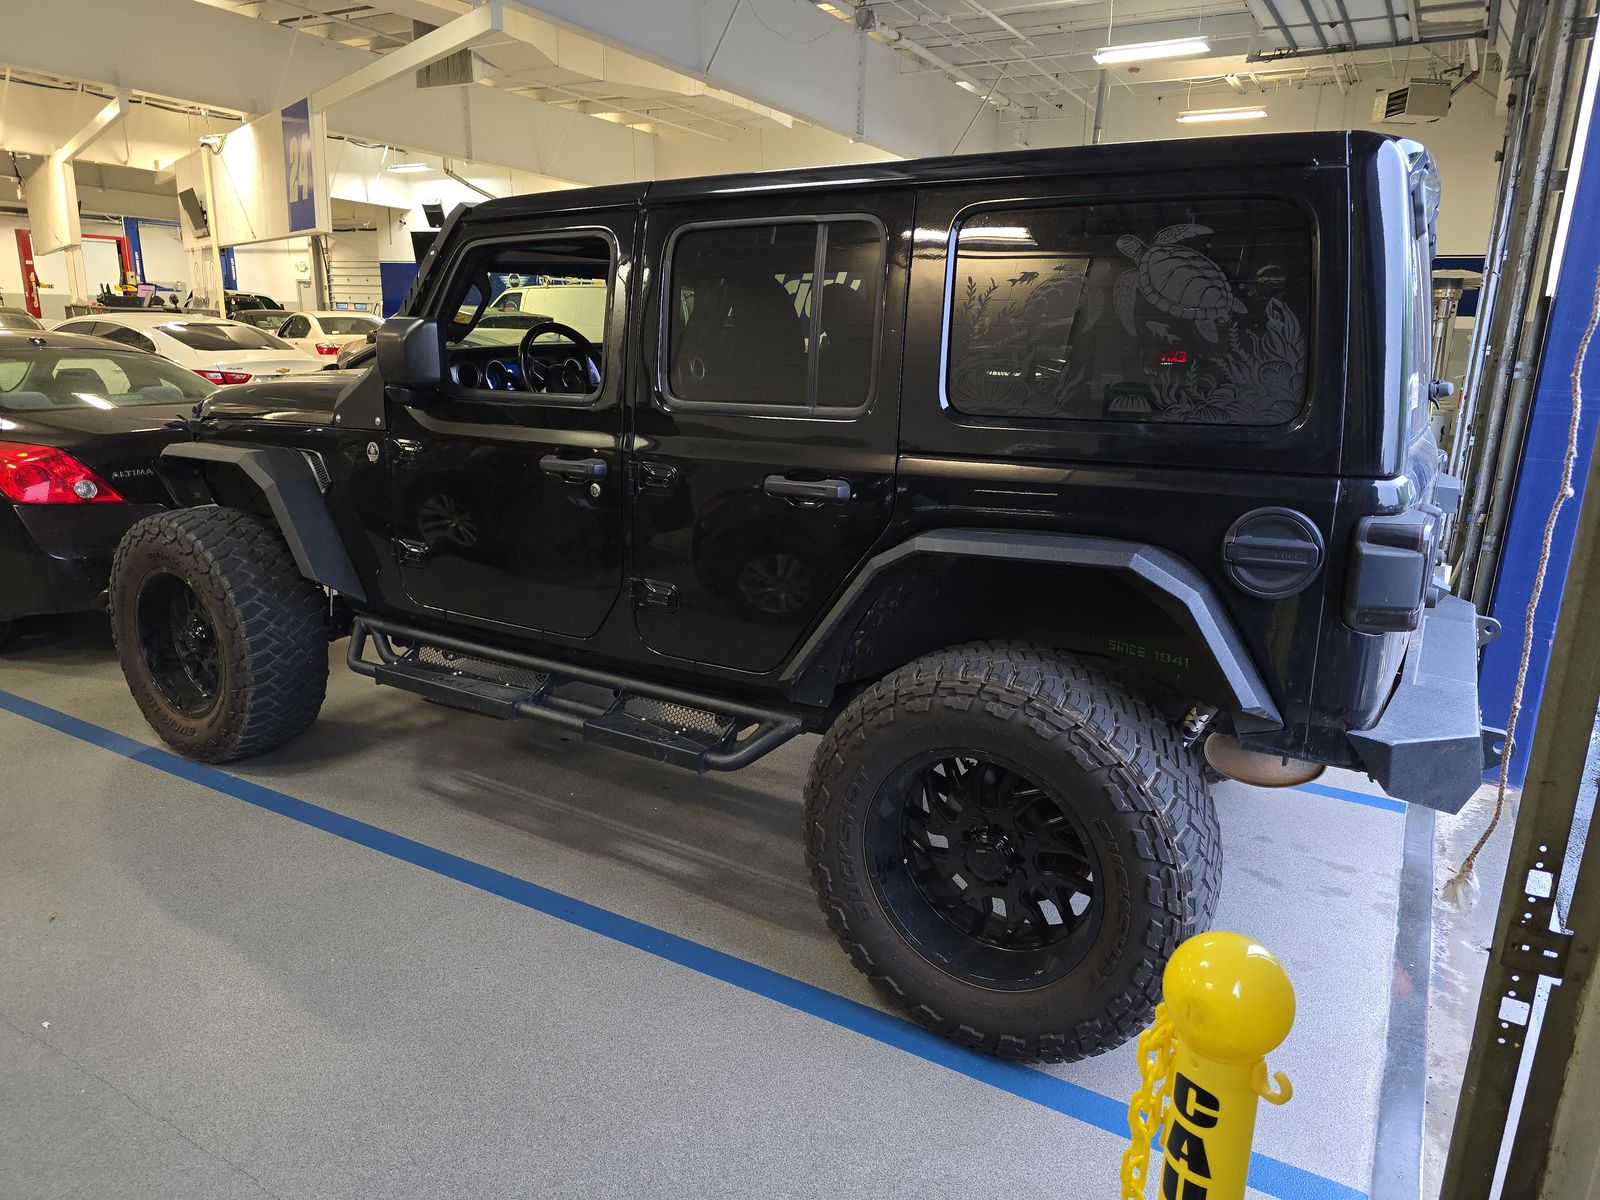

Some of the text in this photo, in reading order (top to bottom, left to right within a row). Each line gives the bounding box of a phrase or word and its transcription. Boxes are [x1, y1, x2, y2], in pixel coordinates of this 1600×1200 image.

[289, 132, 309, 203] 24
[111, 468, 154, 479] ALTIMA
[1154, 650, 1190, 669] 1941
